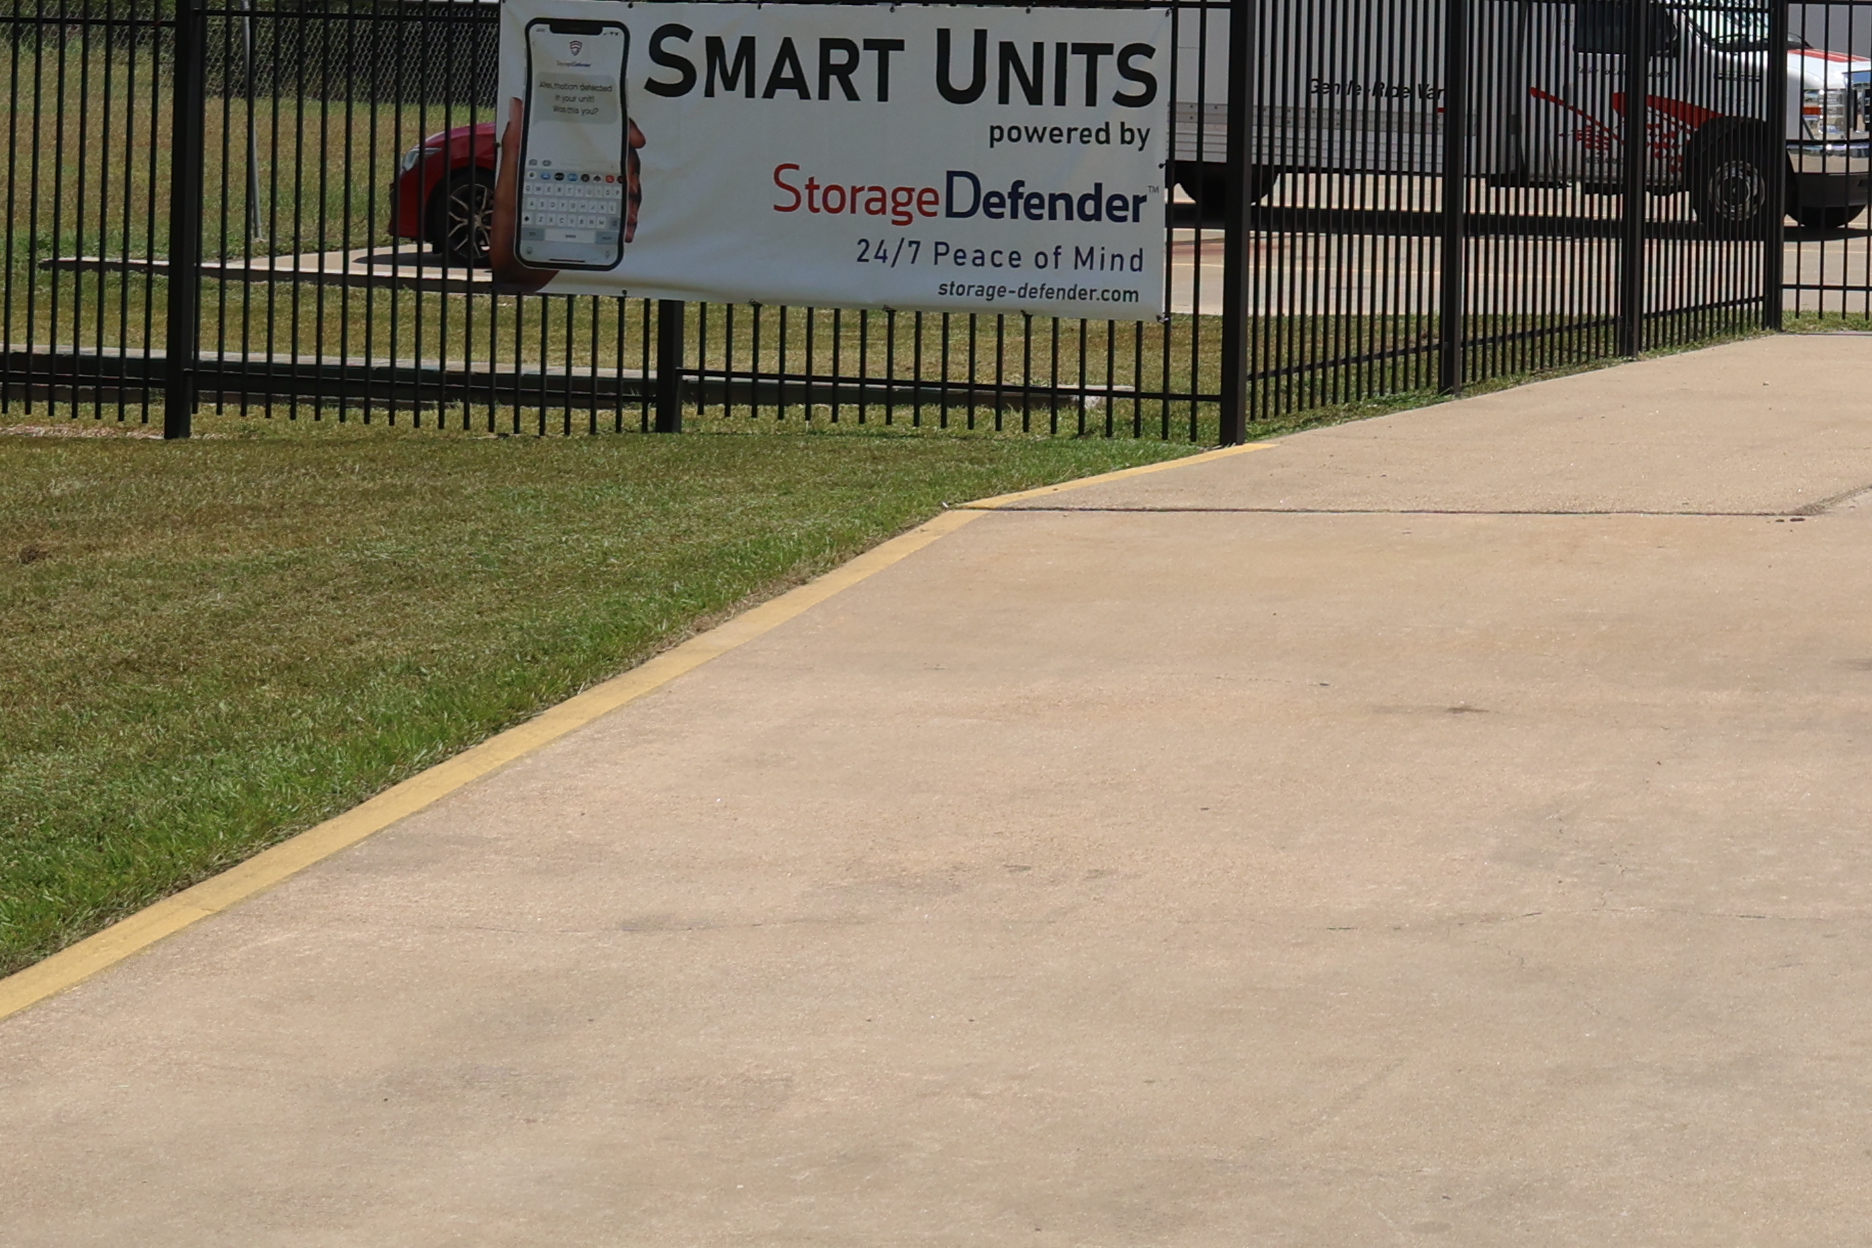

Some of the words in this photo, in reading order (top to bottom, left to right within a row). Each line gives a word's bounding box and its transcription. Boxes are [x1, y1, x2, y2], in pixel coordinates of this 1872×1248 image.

[644, 23, 905, 102] SMART
[936, 28, 1157, 108] UNITS
[989, 121, 1111, 148] powered
[1120, 121, 1151, 152] by
[856, 237, 922, 268] 24/7
[933, 241, 1022, 269] Peace
[1034, 245, 1062, 270] of
[1074, 245, 1144, 273] Mind
[938, 280, 1139, 303] storage-defender.com
